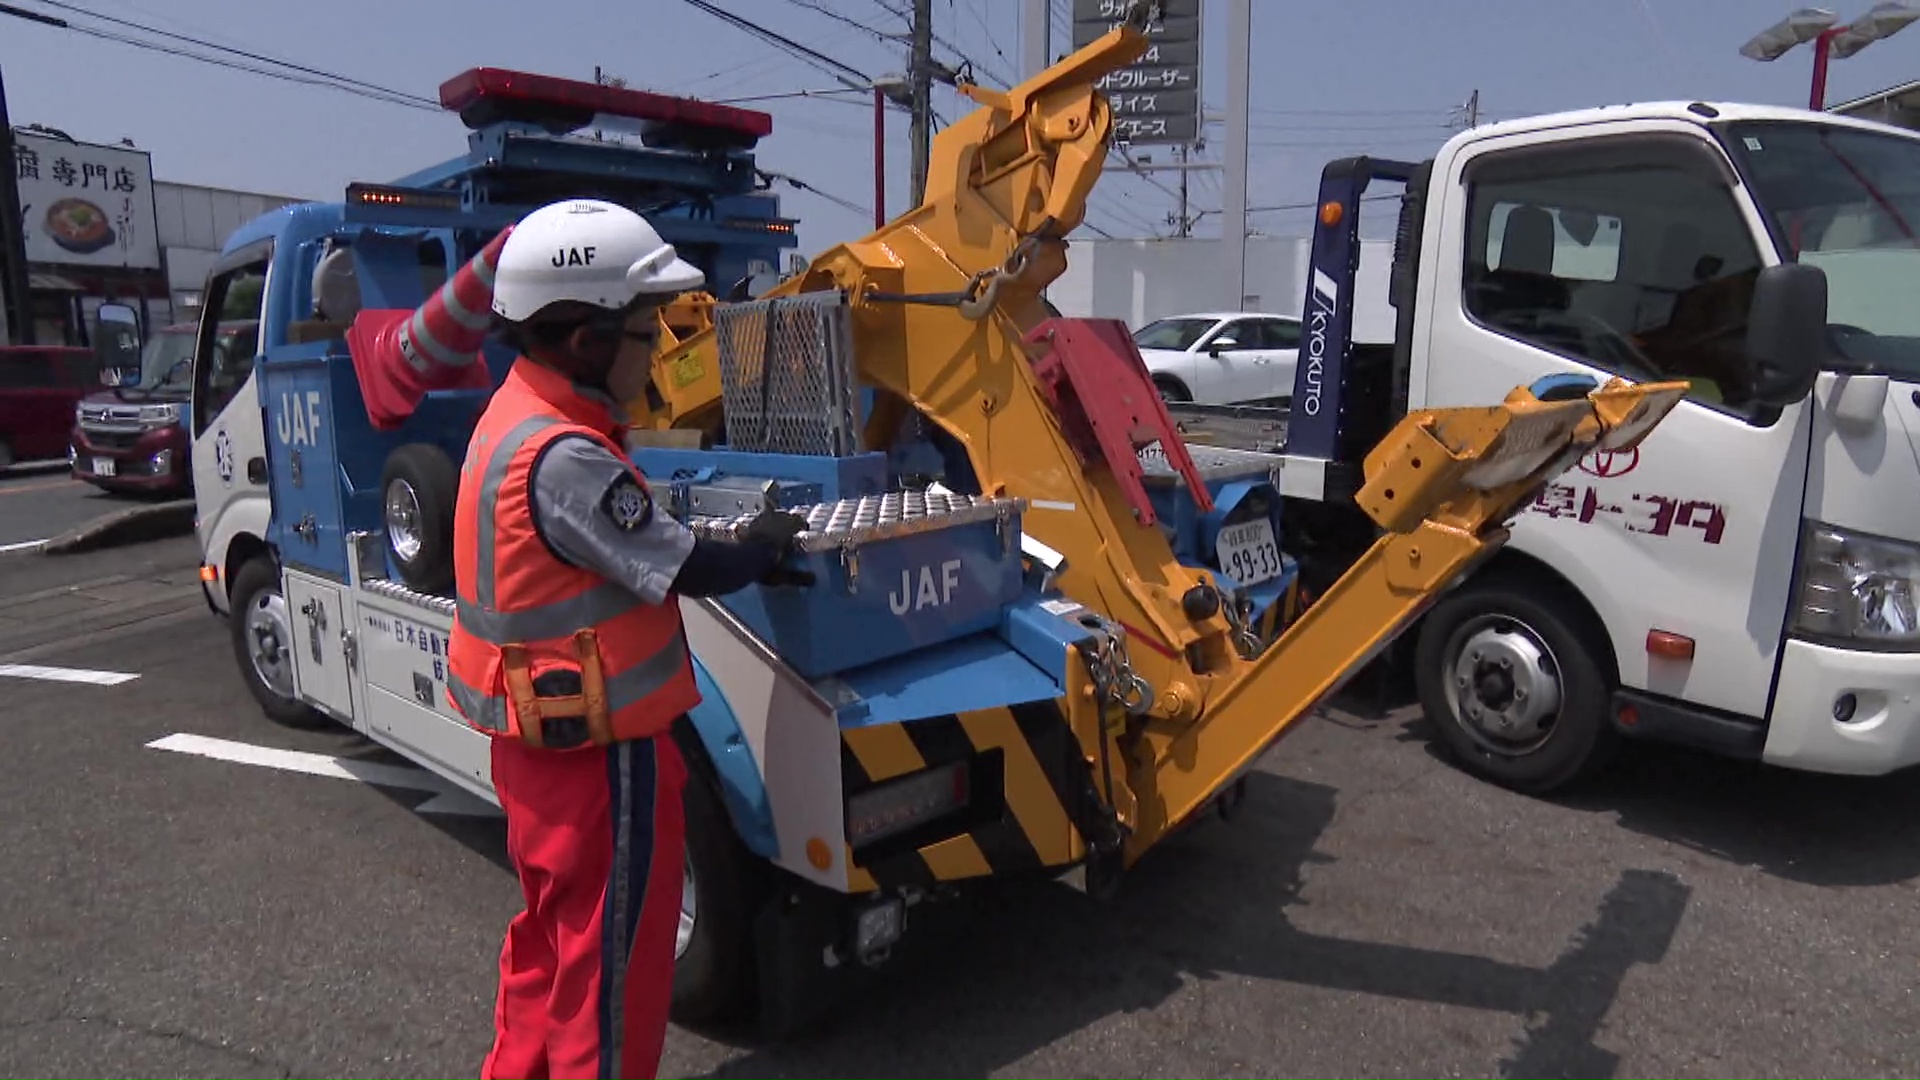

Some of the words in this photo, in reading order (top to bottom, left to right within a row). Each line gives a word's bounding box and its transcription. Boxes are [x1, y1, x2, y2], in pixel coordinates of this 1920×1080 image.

[552, 247, 596, 267] JAF
[1305, 311, 1327, 416] KYOKUTO
[277, 391, 320, 447] JAF
[889, 559, 961, 615] JAF
